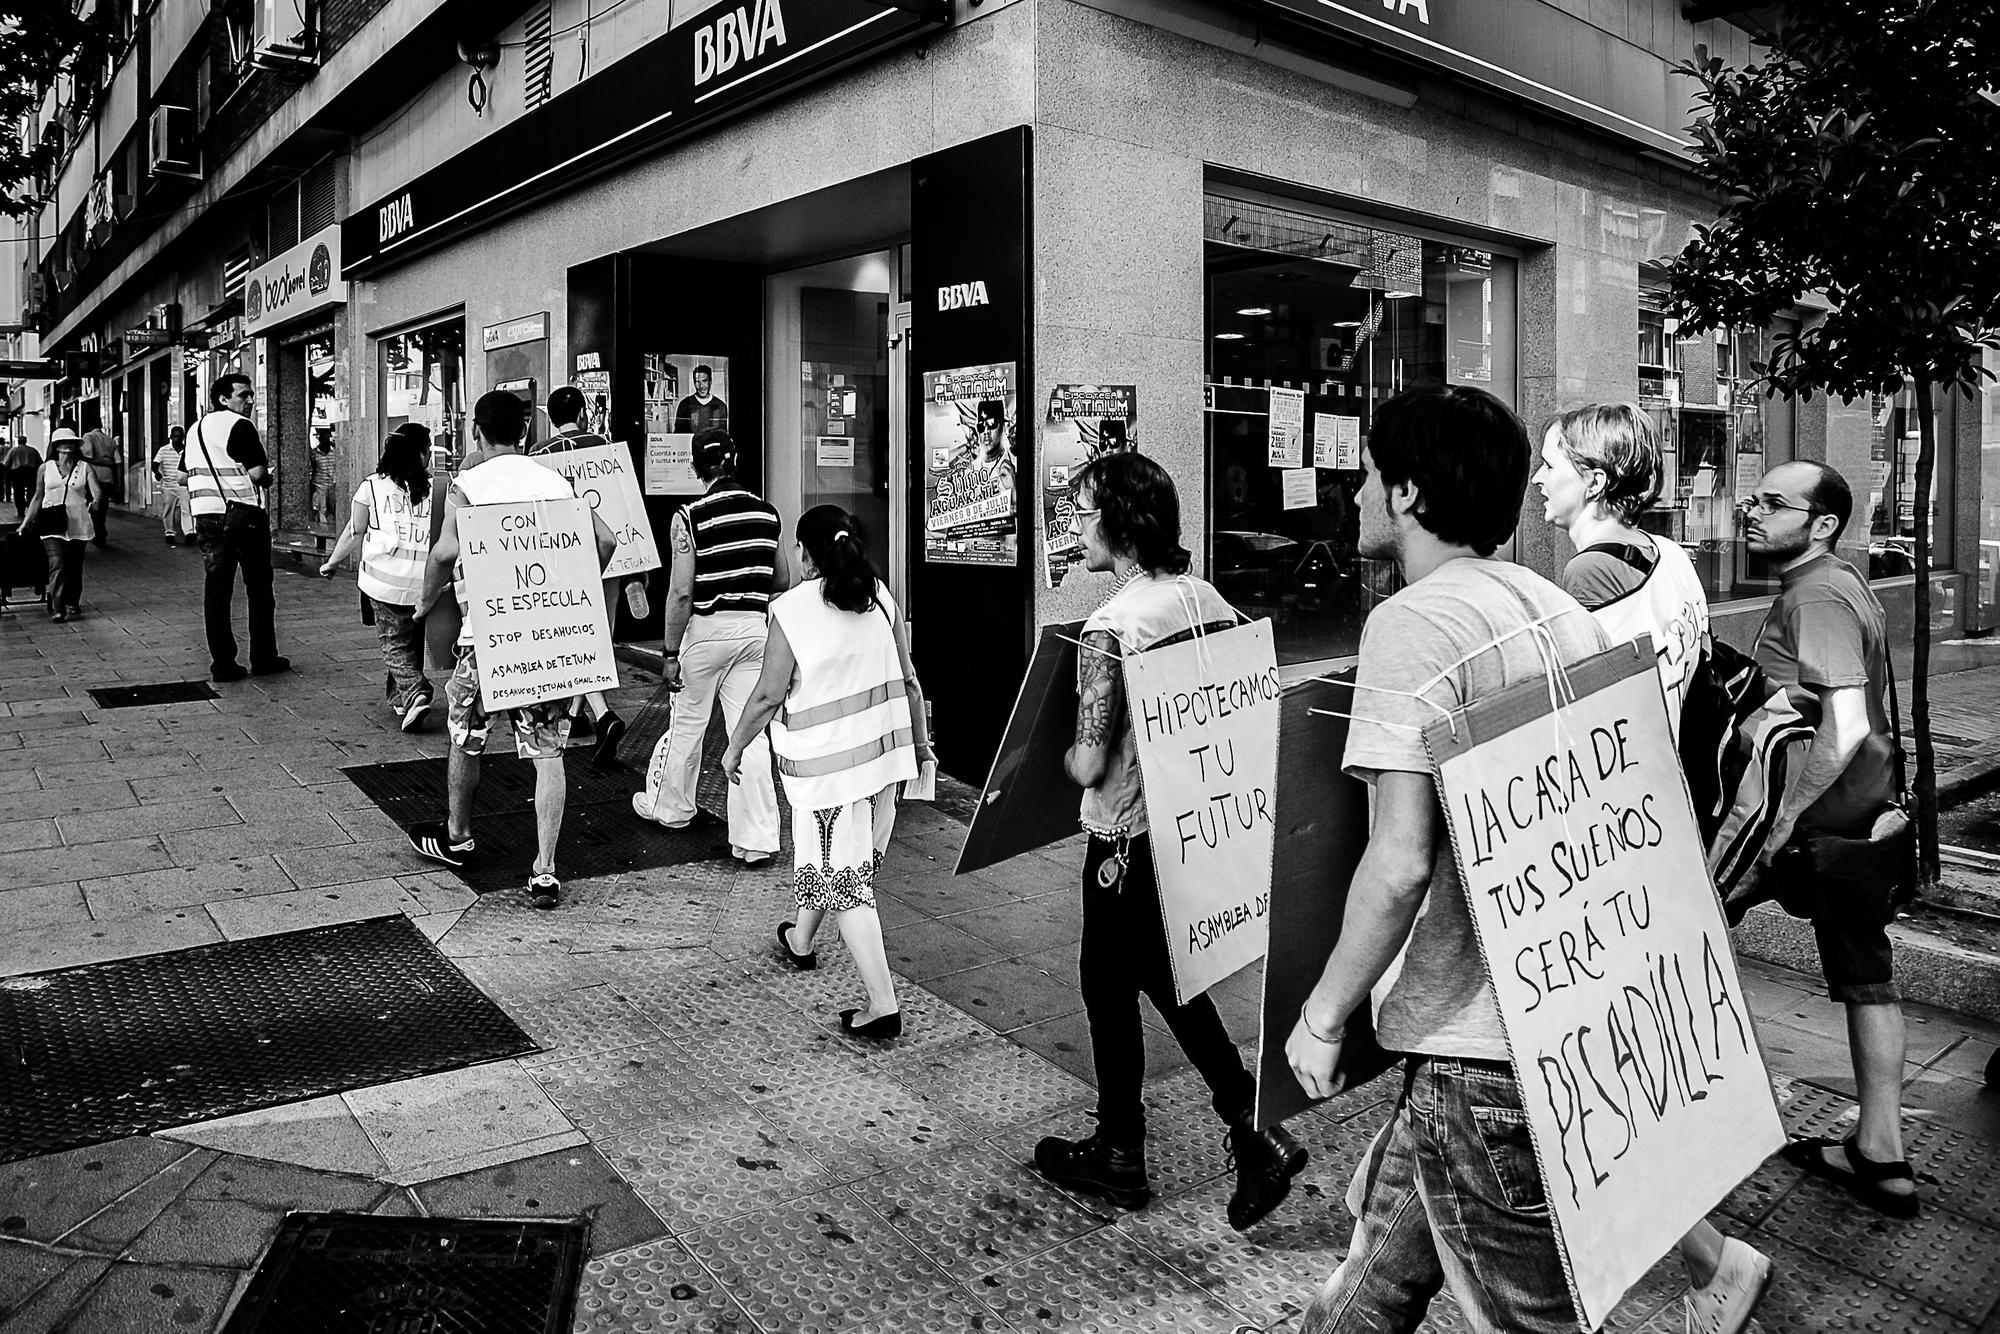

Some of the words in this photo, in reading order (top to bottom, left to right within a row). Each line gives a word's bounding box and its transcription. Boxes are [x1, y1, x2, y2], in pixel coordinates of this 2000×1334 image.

[694, 0, 787, 86] BBVA
[380, 193, 413, 242] BBVA
[938, 281, 989, 311] BBVA
[577, 352, 600, 371] BBVA
[501, 511, 536, 532] CON
[930, 509, 964, 528] VIERNES
[965, 508, 971, 517] 8
[973, 505, 983, 515] DE
[985, 495, 1009, 511] JULIO
[468, 540, 488, 555] LA
[499, 531, 582, 551] VIVIENDA
[515, 562, 546, 590] NO
[486, 598, 507, 617] SE
[511, 589, 592, 611] ESPECULA
[489, 631, 522, 648] STOP
[531, 623, 595, 641] DESAHUCIOS
[491, 659, 544, 678] ASAMBLEA
[546, 659, 557, 670] DE
[557, 652, 597, 667] TETUAN
[1189, 739, 1235, 782] TU
[1464, 787, 1508, 867] LA
[1507, 749, 1591, 830] CASA
[1590, 718, 1639, 781] DE
[1487, 864, 1545, 930] TUS
[1551, 793, 1663, 898] SUEÑOS
[1189, 902, 1253, 955] ASAMBLEA
[1515, 901, 1606, 1013] SERÁ
[1602, 884, 1650, 937] TU
